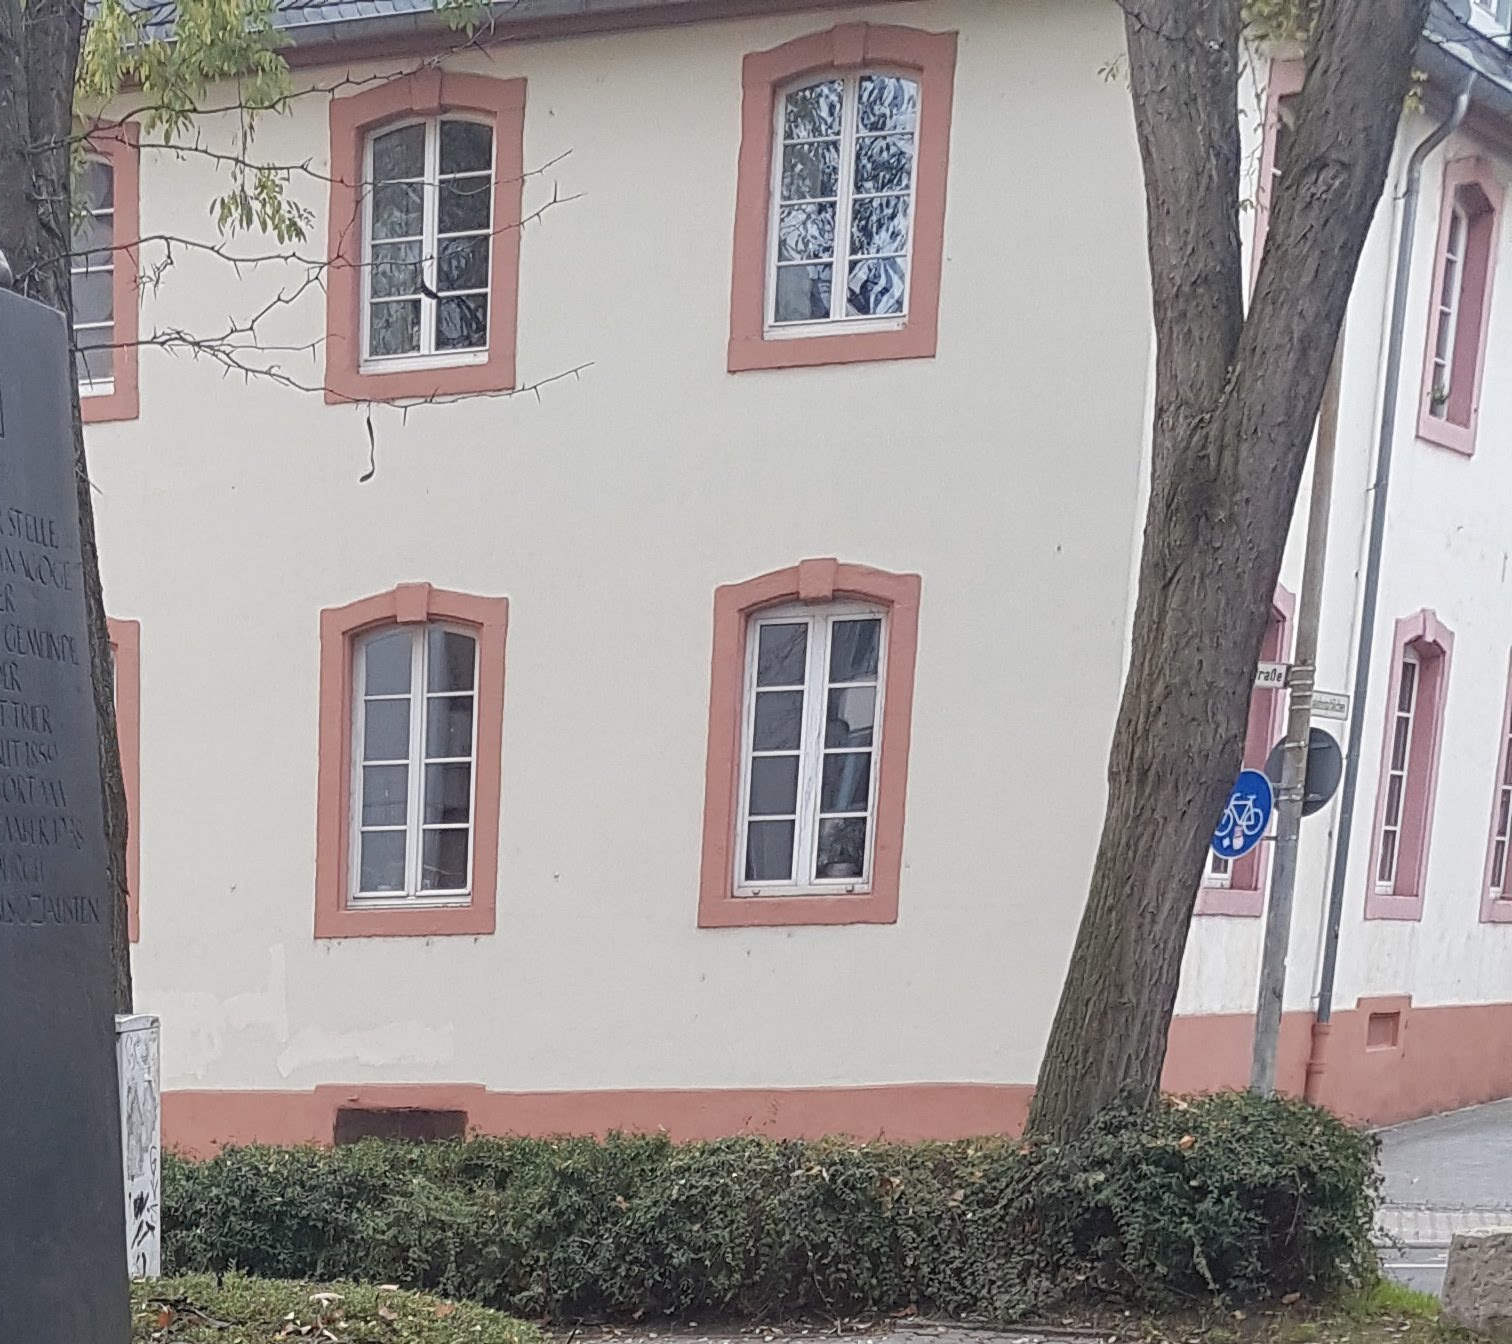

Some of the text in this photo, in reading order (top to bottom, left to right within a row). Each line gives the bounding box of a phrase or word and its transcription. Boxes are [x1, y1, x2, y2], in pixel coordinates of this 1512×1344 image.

[7, 505, 59, 550] STELLE
[4, 622, 80, 666] GEMEINDE
[10, 699, 53, 735] TRIER
